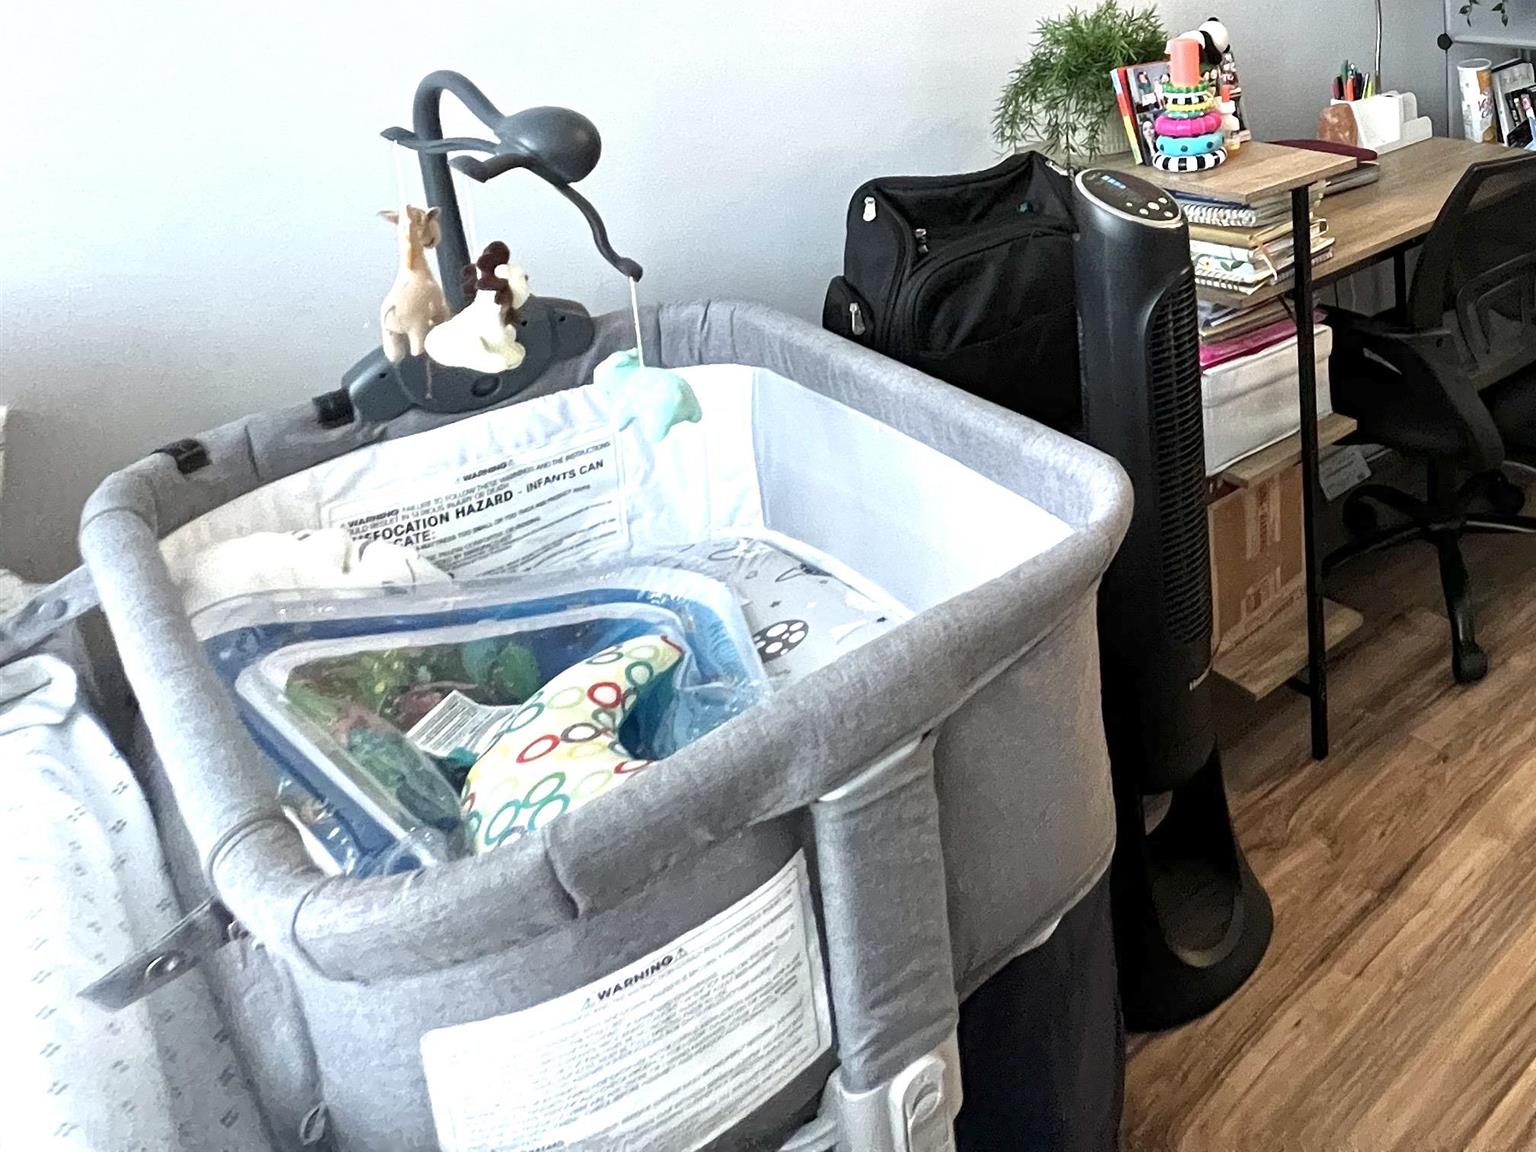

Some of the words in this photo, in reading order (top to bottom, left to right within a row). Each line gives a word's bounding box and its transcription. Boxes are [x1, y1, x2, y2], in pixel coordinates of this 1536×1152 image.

[352, 512, 449, 541] FFOCATION
[455, 490, 514, 519] HAZARD
[526, 469, 576, 493] INFANTS
[579, 459, 604, 475] CAN
[597, 955, 674, 1001] WARNING
